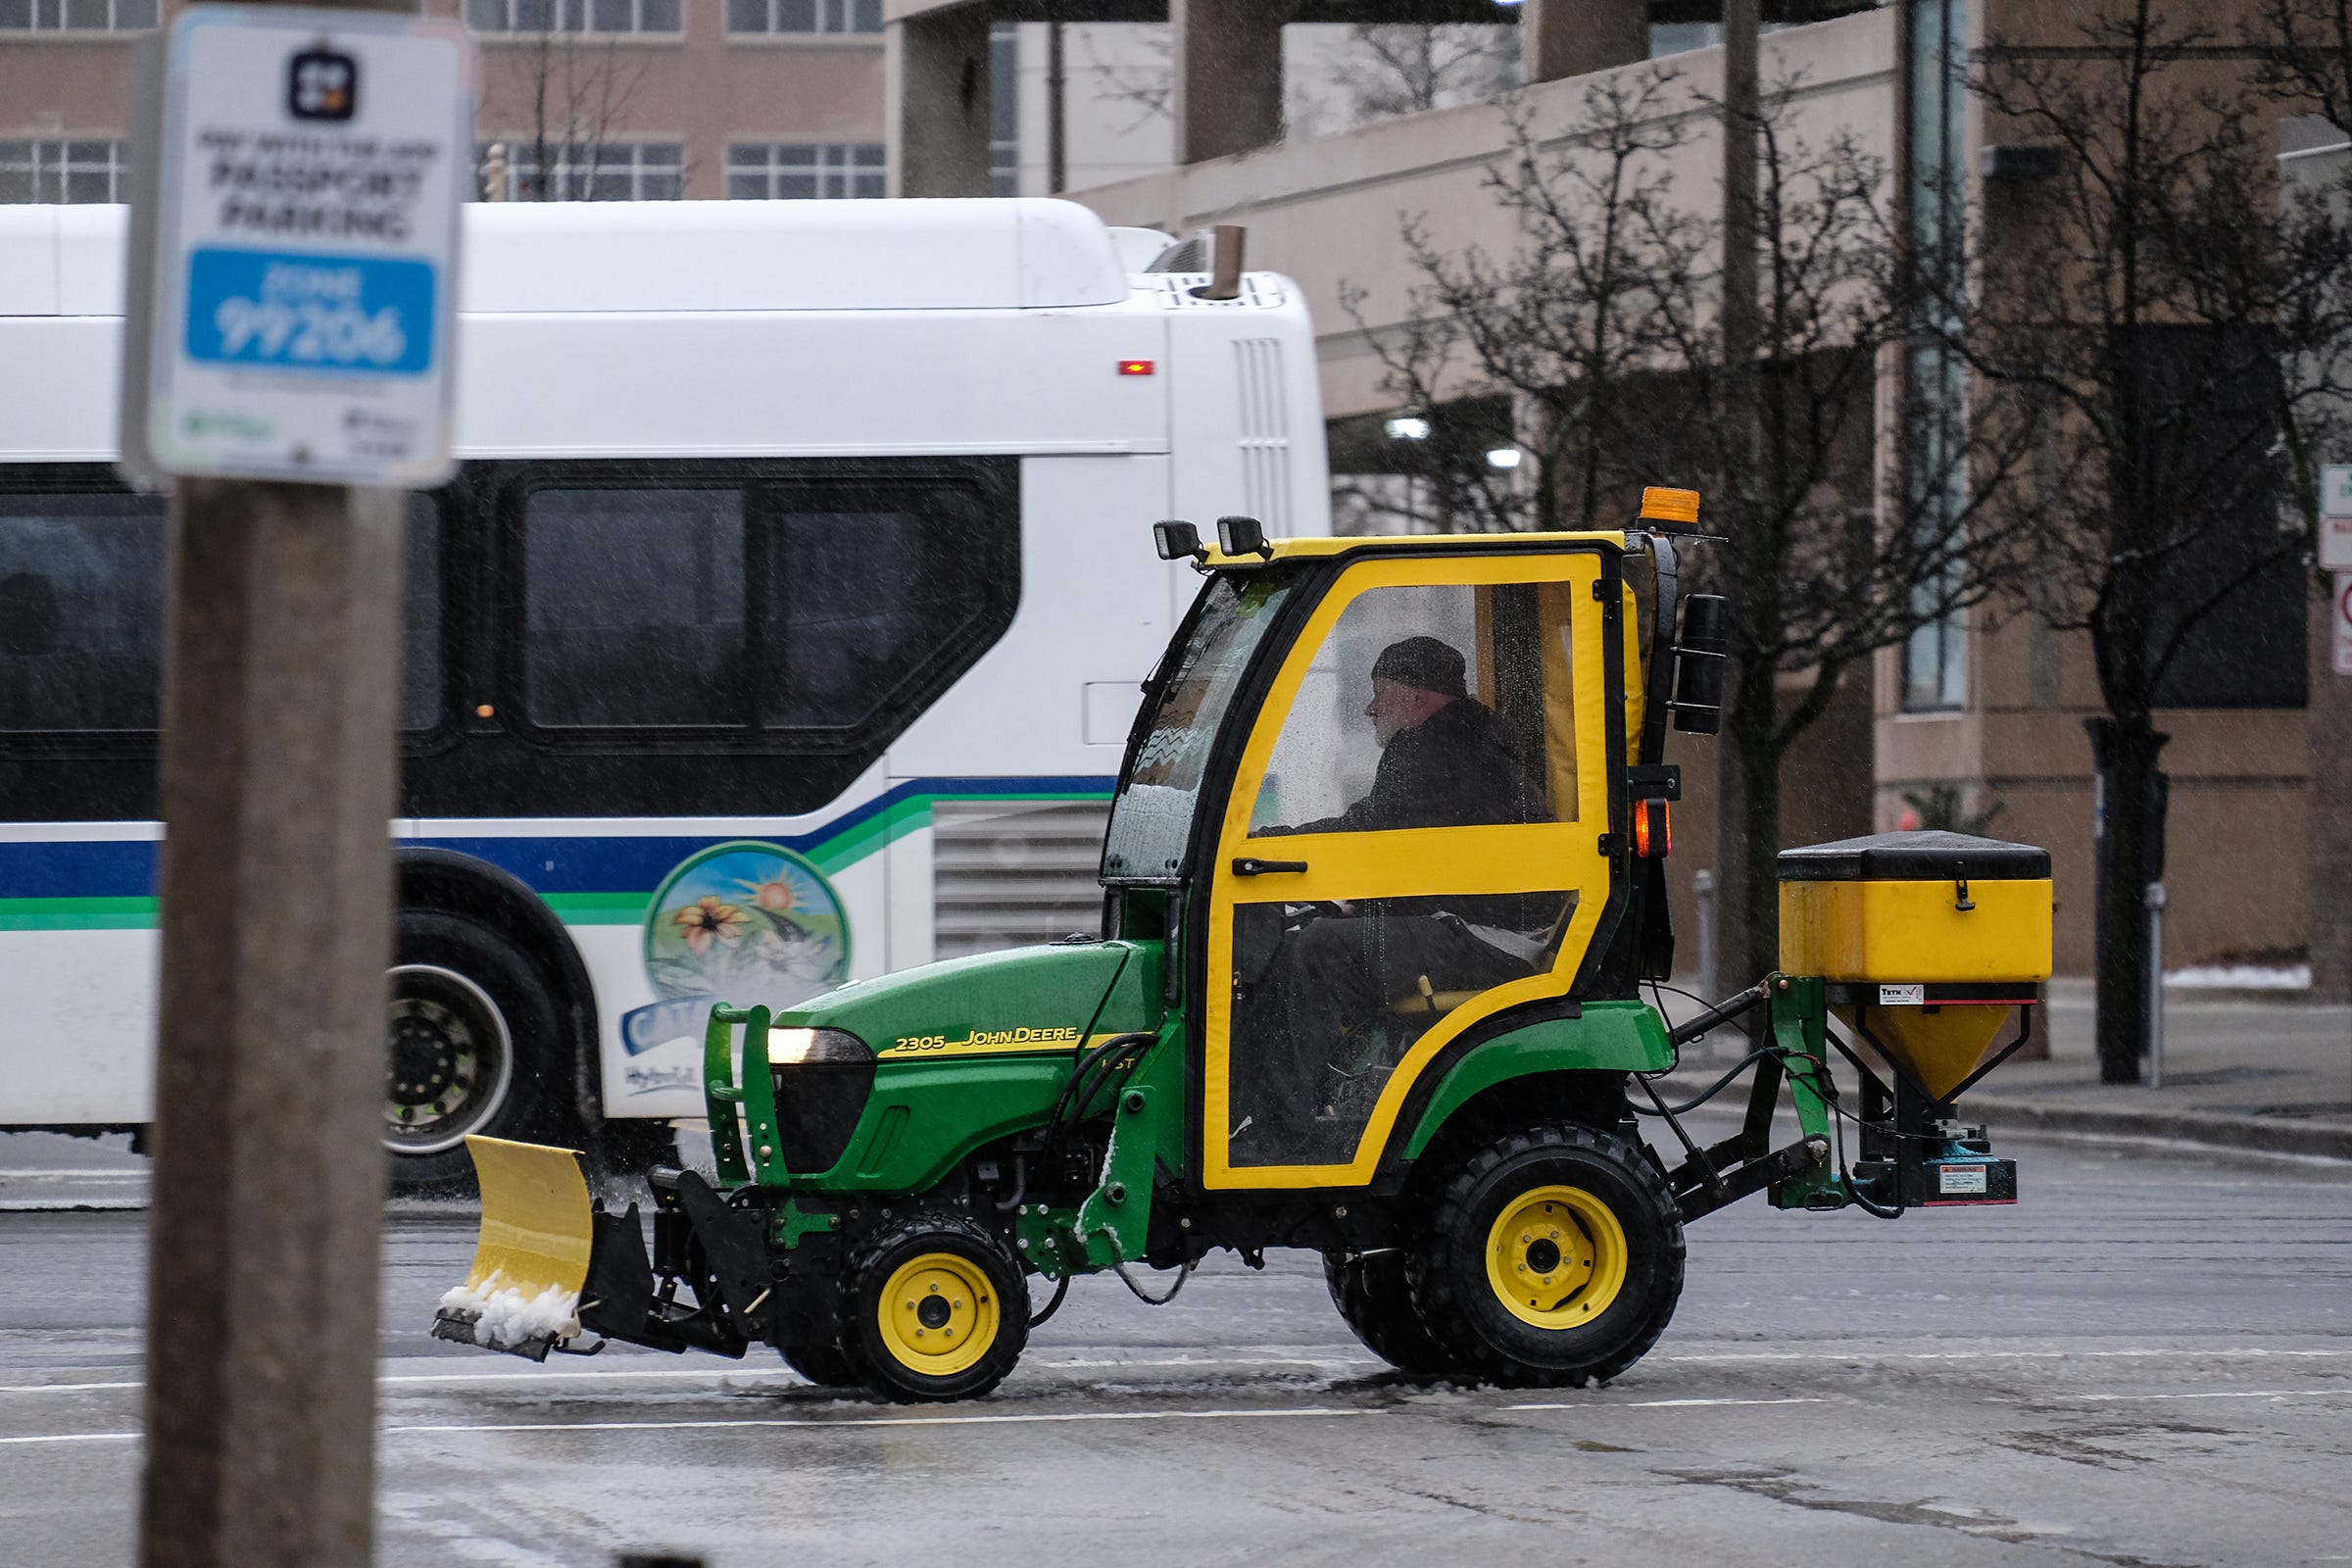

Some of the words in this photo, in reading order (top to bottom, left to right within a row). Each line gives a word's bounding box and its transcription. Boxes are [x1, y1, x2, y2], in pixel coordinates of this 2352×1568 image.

[209, 159, 422, 200] PASSPORT
[219, 199, 411, 240] PARKING
[261, 265, 363, 299] ZONE
[216, 297, 407, 364] 99206
[895, 1035, 946, 1052] 2305
